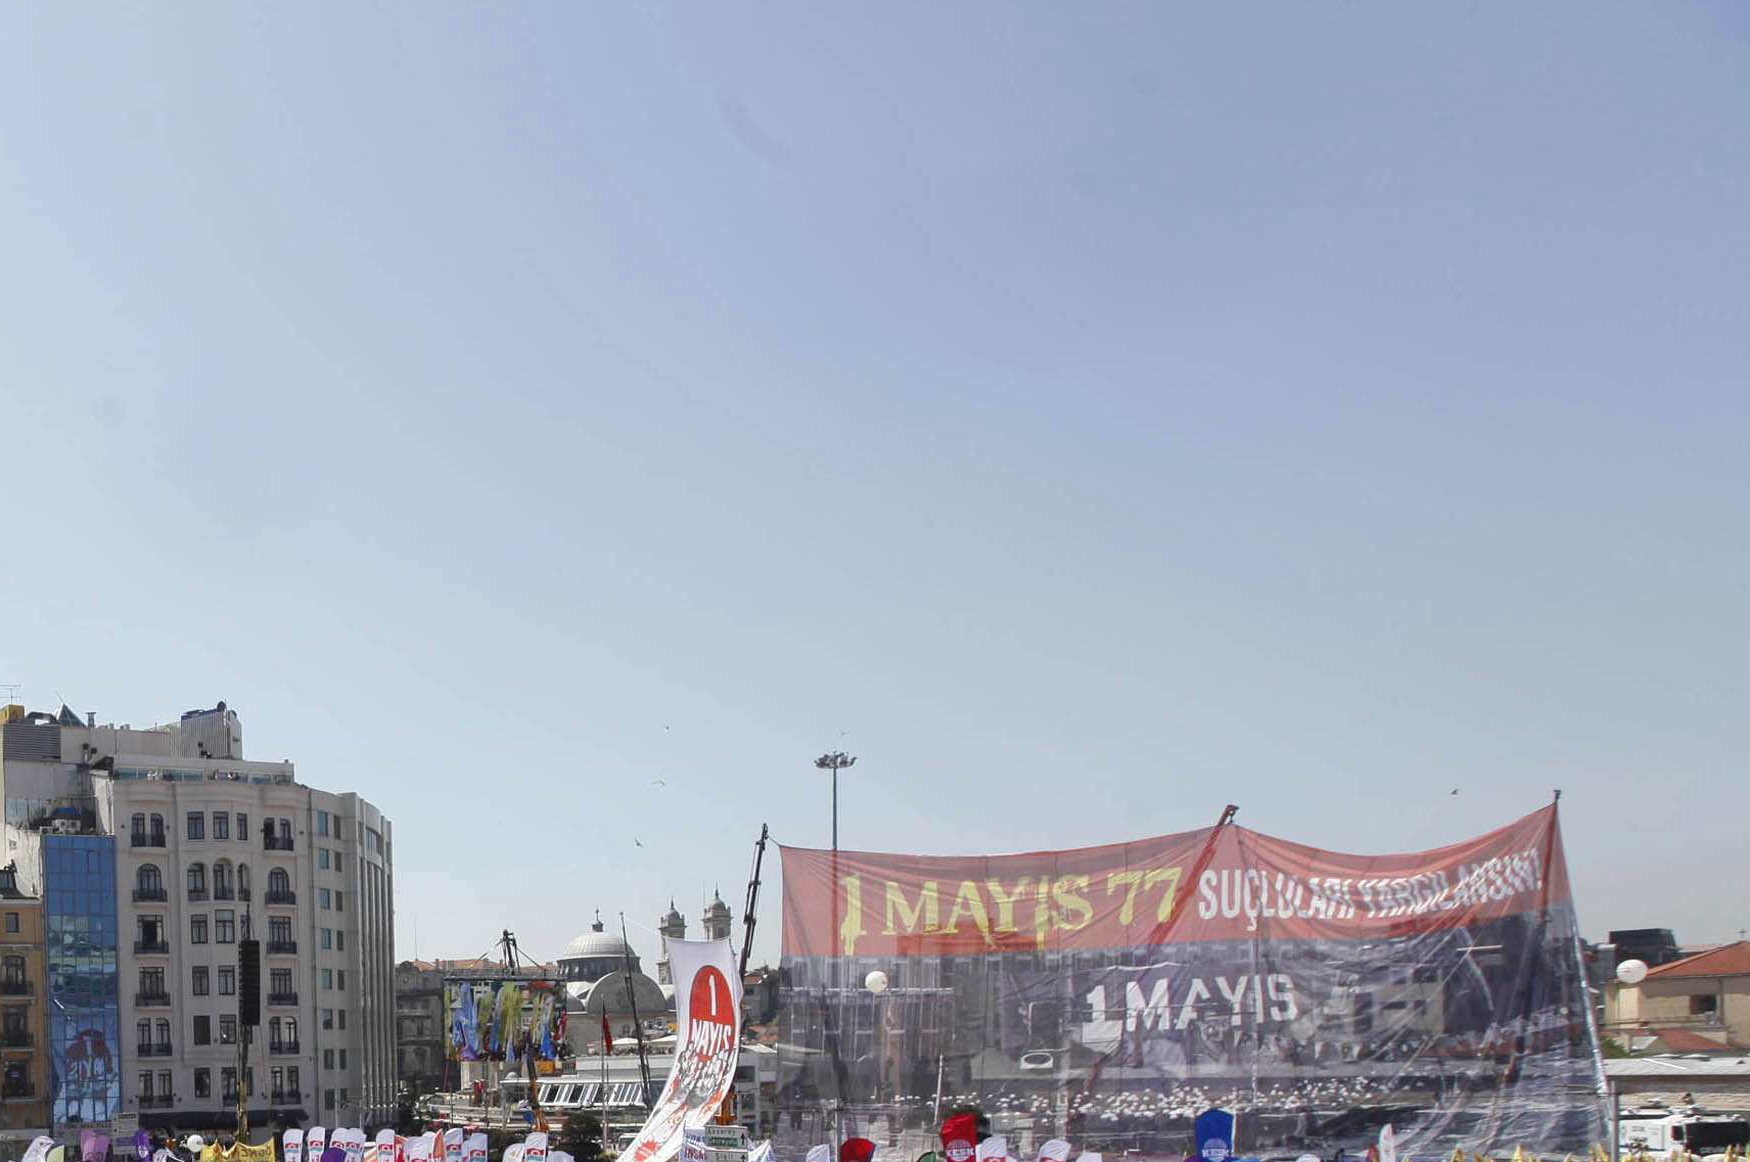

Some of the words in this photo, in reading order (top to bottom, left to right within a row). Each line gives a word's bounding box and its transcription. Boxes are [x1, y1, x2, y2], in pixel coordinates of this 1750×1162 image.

[840, 874, 868, 955] 1
[881, 868, 1093, 950] MAYIS
[1107, 867, 1182, 927] 77
[1199, 868, 1356, 931] SUÇLULARI
[708, 974, 717, 1017] 1
[1126, 973, 1298, 1033] MAYIS
